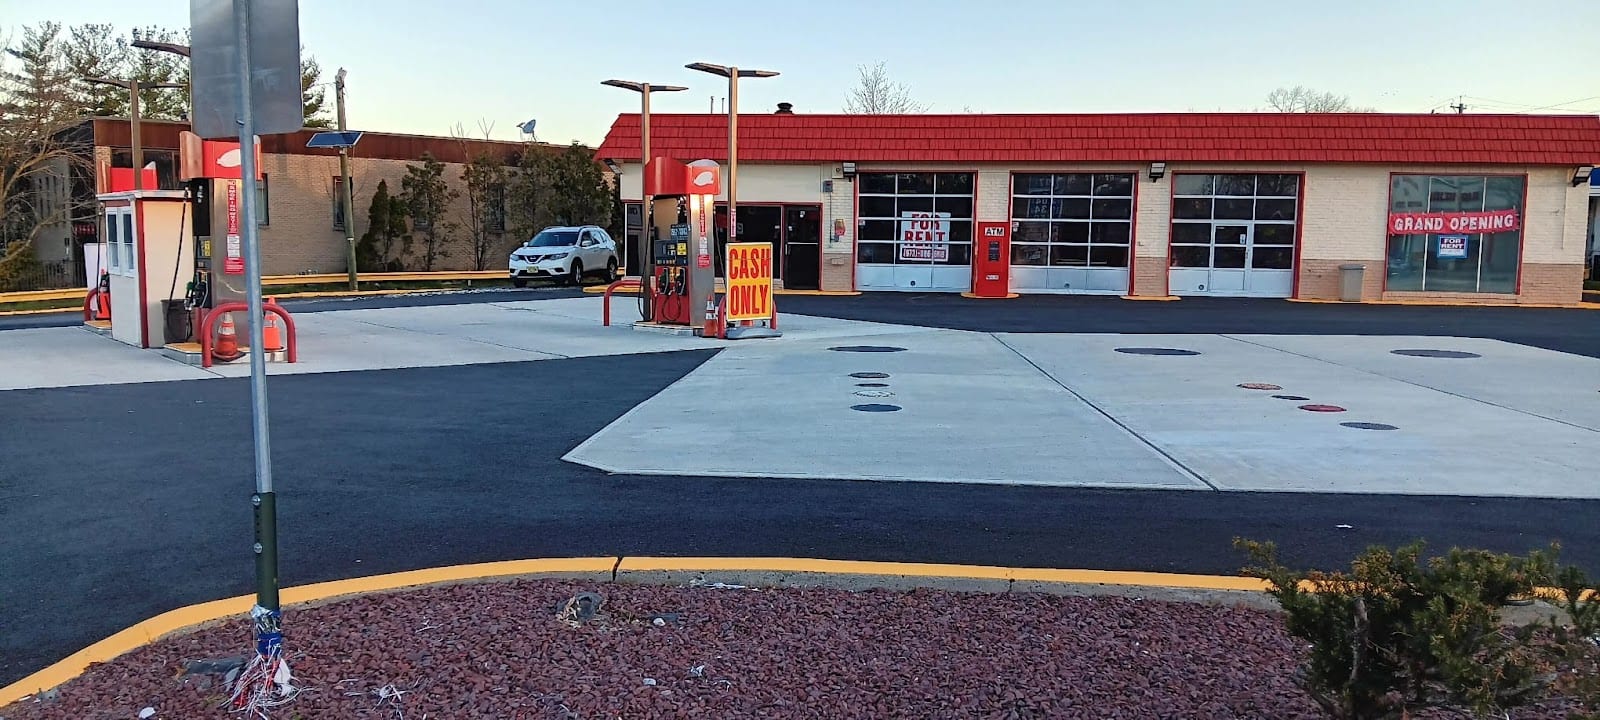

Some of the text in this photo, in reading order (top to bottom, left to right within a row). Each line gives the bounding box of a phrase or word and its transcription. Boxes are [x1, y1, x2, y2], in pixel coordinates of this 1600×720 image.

[911, 213, 940, 230] FOR
[1394, 214, 1513, 231] GRAND OPENING
[904, 231, 945, 247] RENT
[986, 227, 1004, 235] ATM
[729, 248, 770, 279] CASH
[730, 284, 768, 315] ONLY
